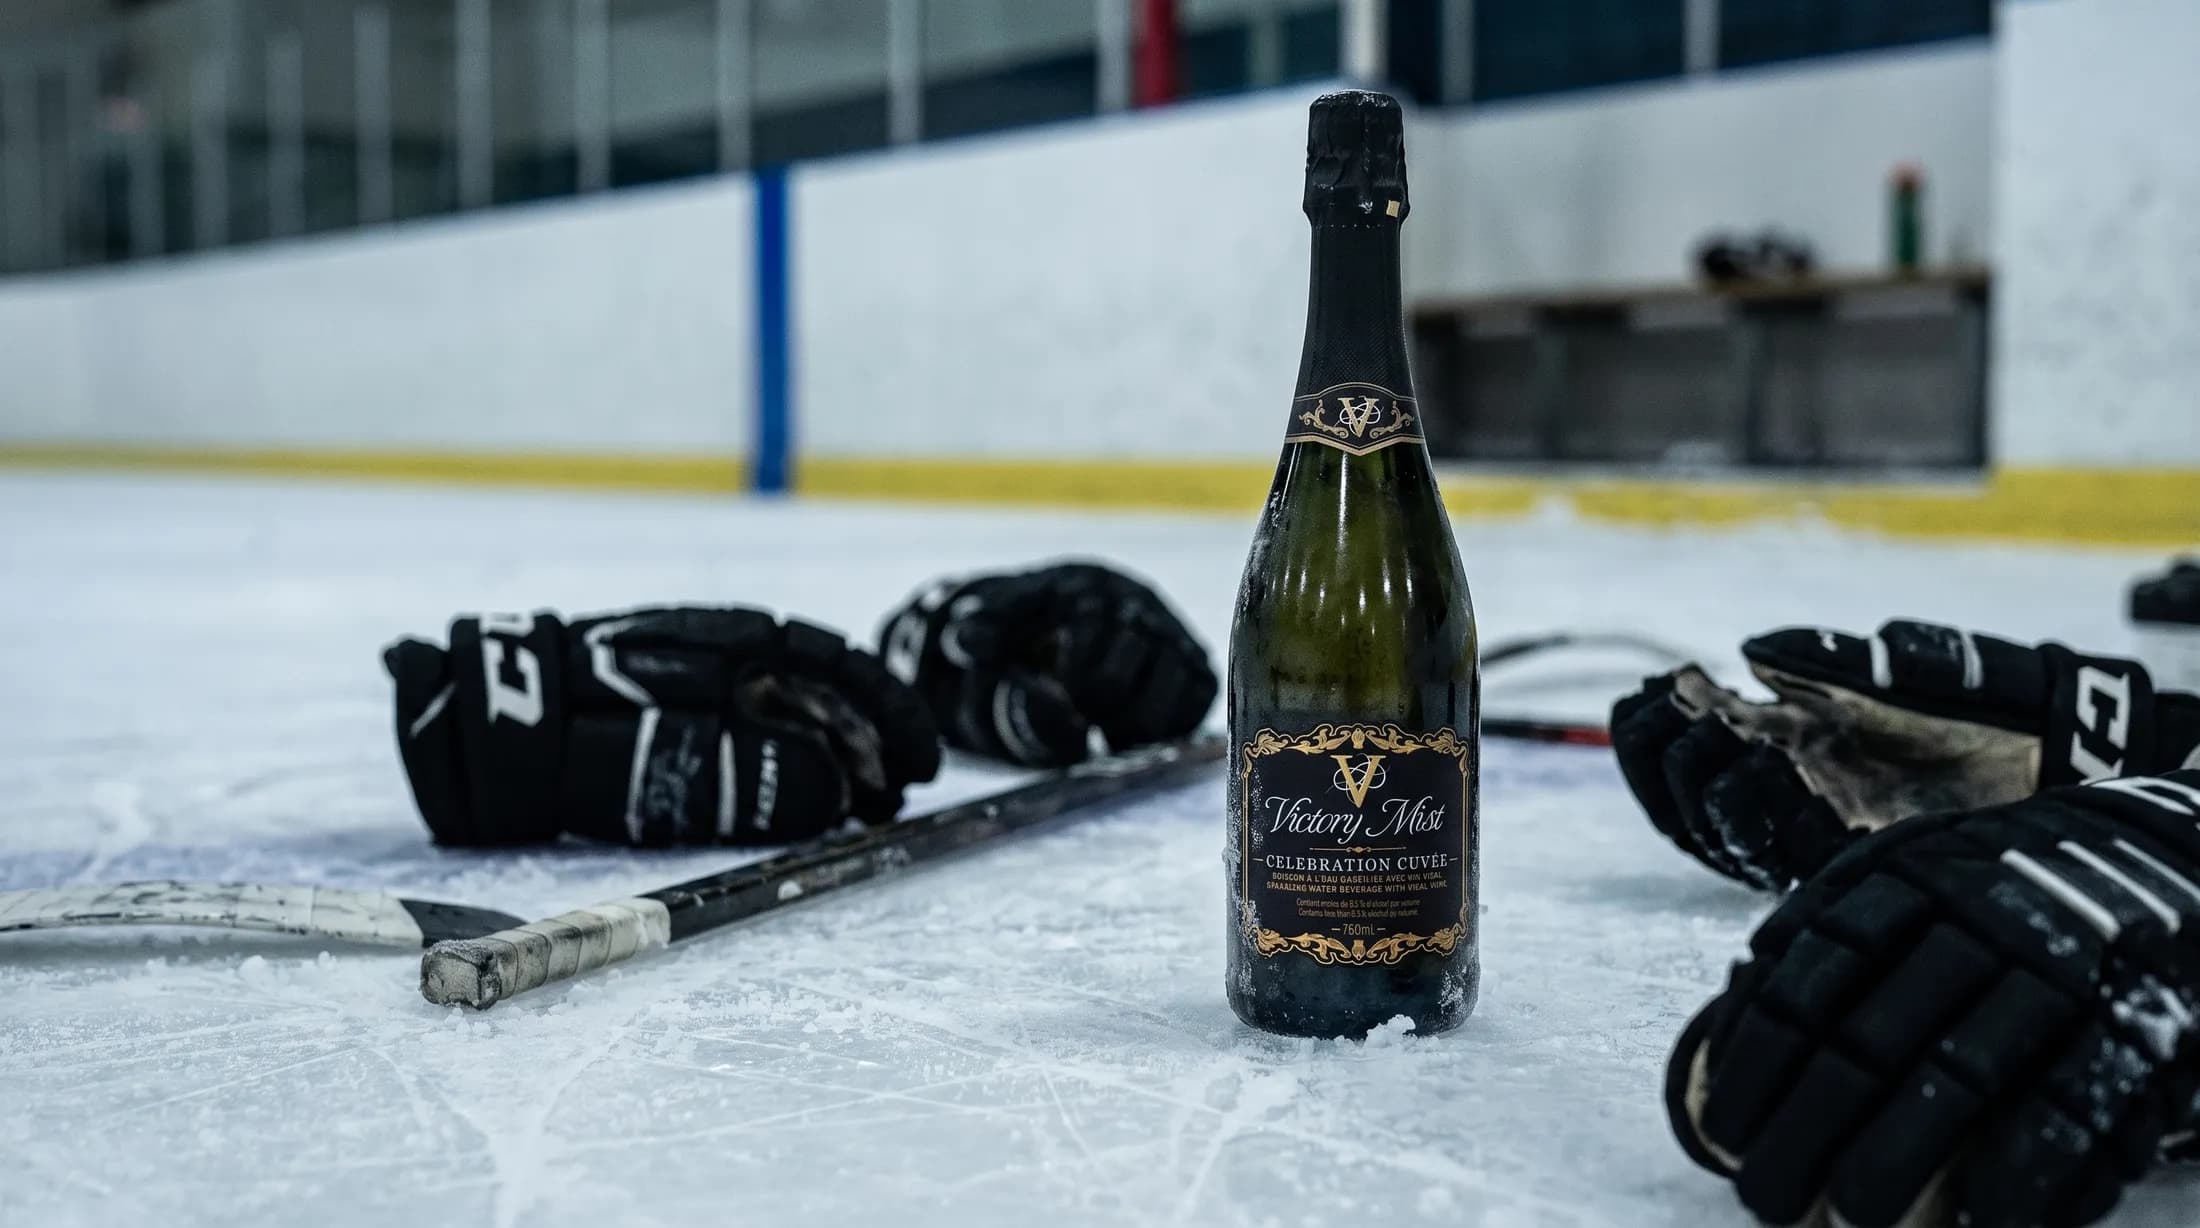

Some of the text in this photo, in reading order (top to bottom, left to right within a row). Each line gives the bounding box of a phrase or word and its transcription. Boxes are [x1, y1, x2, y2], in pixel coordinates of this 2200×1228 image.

[1330, 753, 1386, 808] V
[1265, 796, 1445, 844] Victory Mist
[1266, 852, 1448, 872] CELEBRATION CUVÉE
[1308, 885, 1337, 893] WATER
[1339, 885, 1383, 893] BEVERAGE
[1385, 884, 1406, 893] WITH
